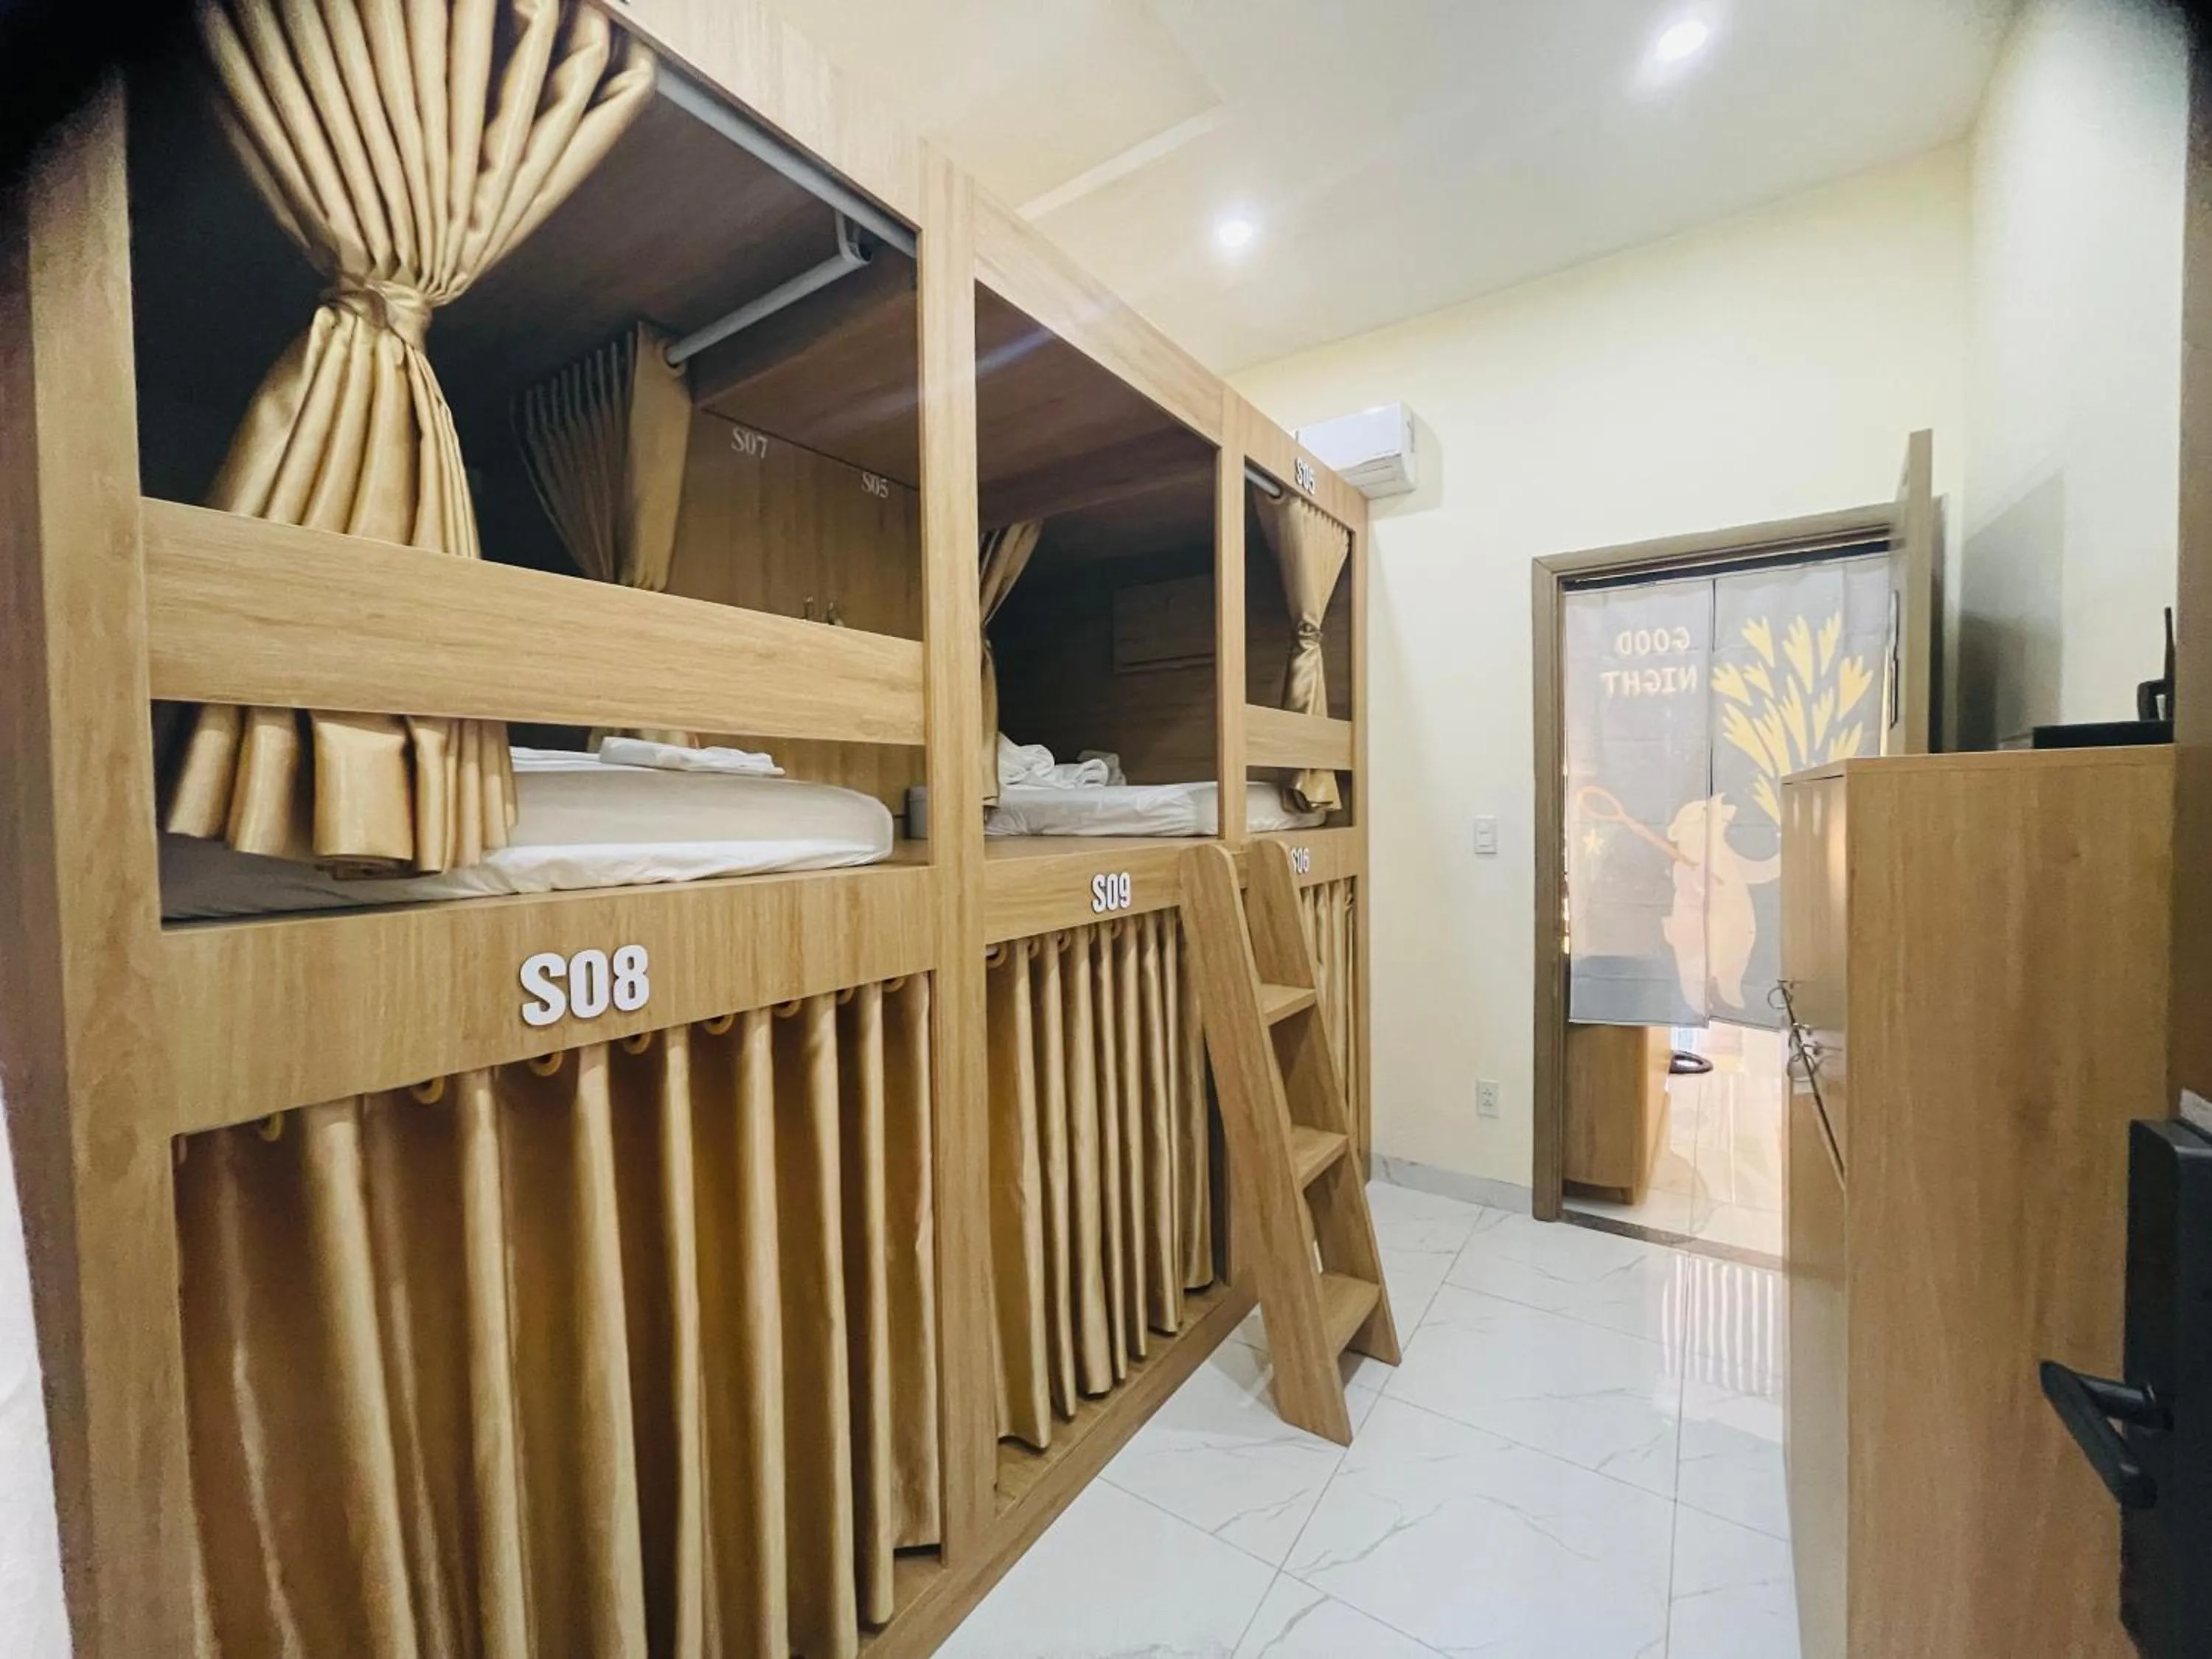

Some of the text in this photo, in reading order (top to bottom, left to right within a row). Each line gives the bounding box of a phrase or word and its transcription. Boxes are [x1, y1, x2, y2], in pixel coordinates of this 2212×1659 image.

[731, 426, 768, 459] S07
[860, 471, 888, 498] S05
[1092, 872, 1130, 913] S09
[520, 945, 650, 1026] S08
